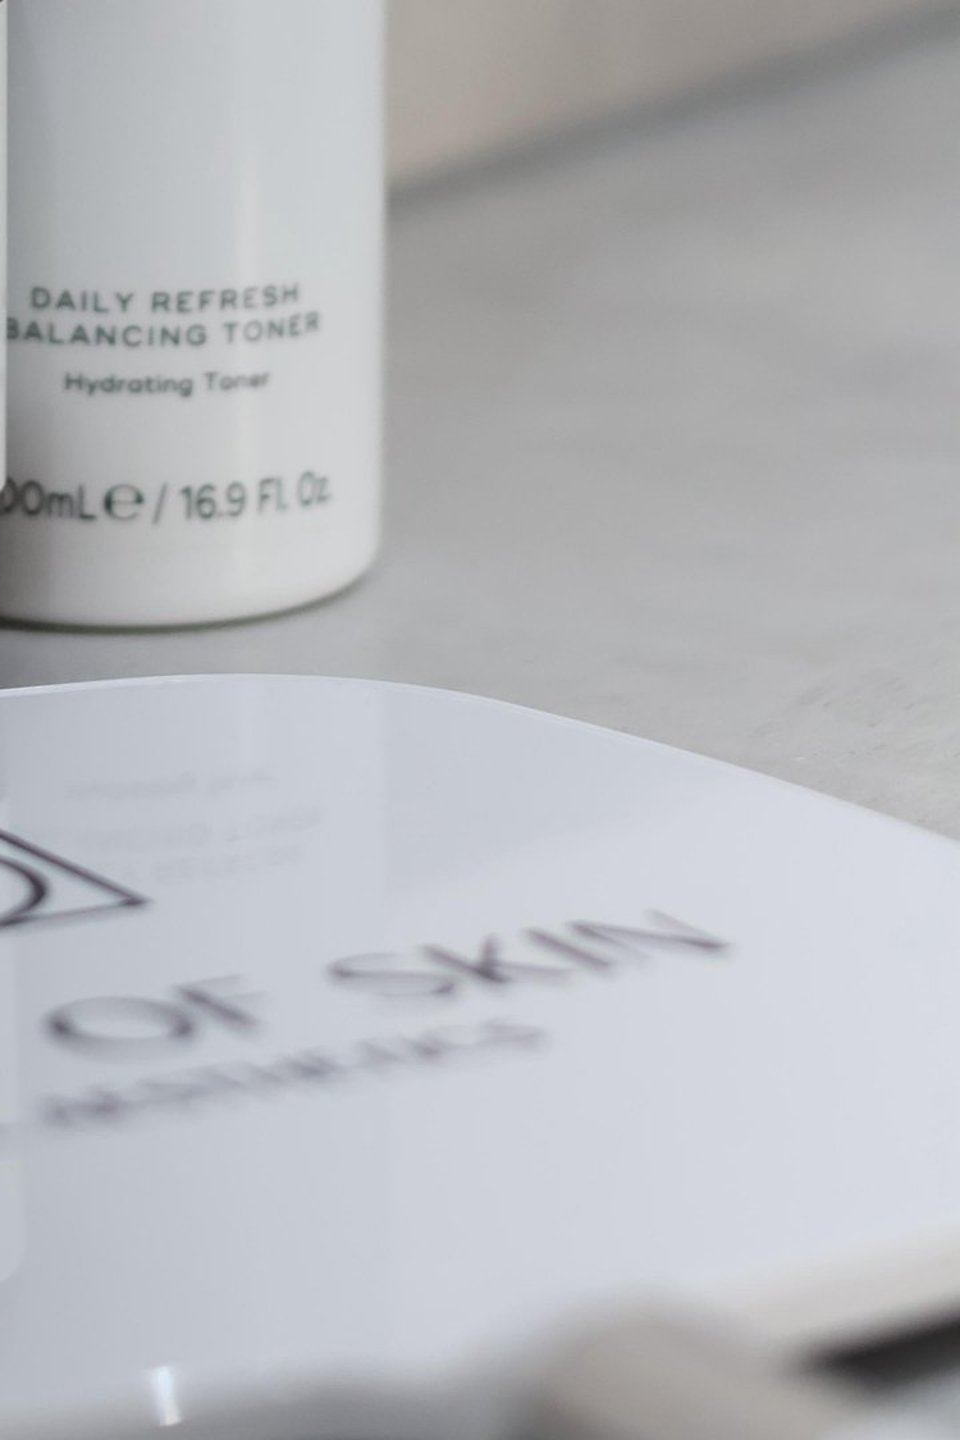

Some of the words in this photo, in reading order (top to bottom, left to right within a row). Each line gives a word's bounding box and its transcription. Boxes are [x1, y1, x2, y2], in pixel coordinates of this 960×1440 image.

[30, 286, 134, 313] DAILY
[151, 282, 300, 314] REFRESH
[5, 316, 208, 348] BALANCING
[222, 311, 320, 344] TONER
[63, 371, 194, 398] Hydrating
[203, 370, 271, 391] Toner
[180, 481, 248, 521] 16.9
[44, 972, 266, 1060] OF
[324, 908, 734, 1014] SKIN
